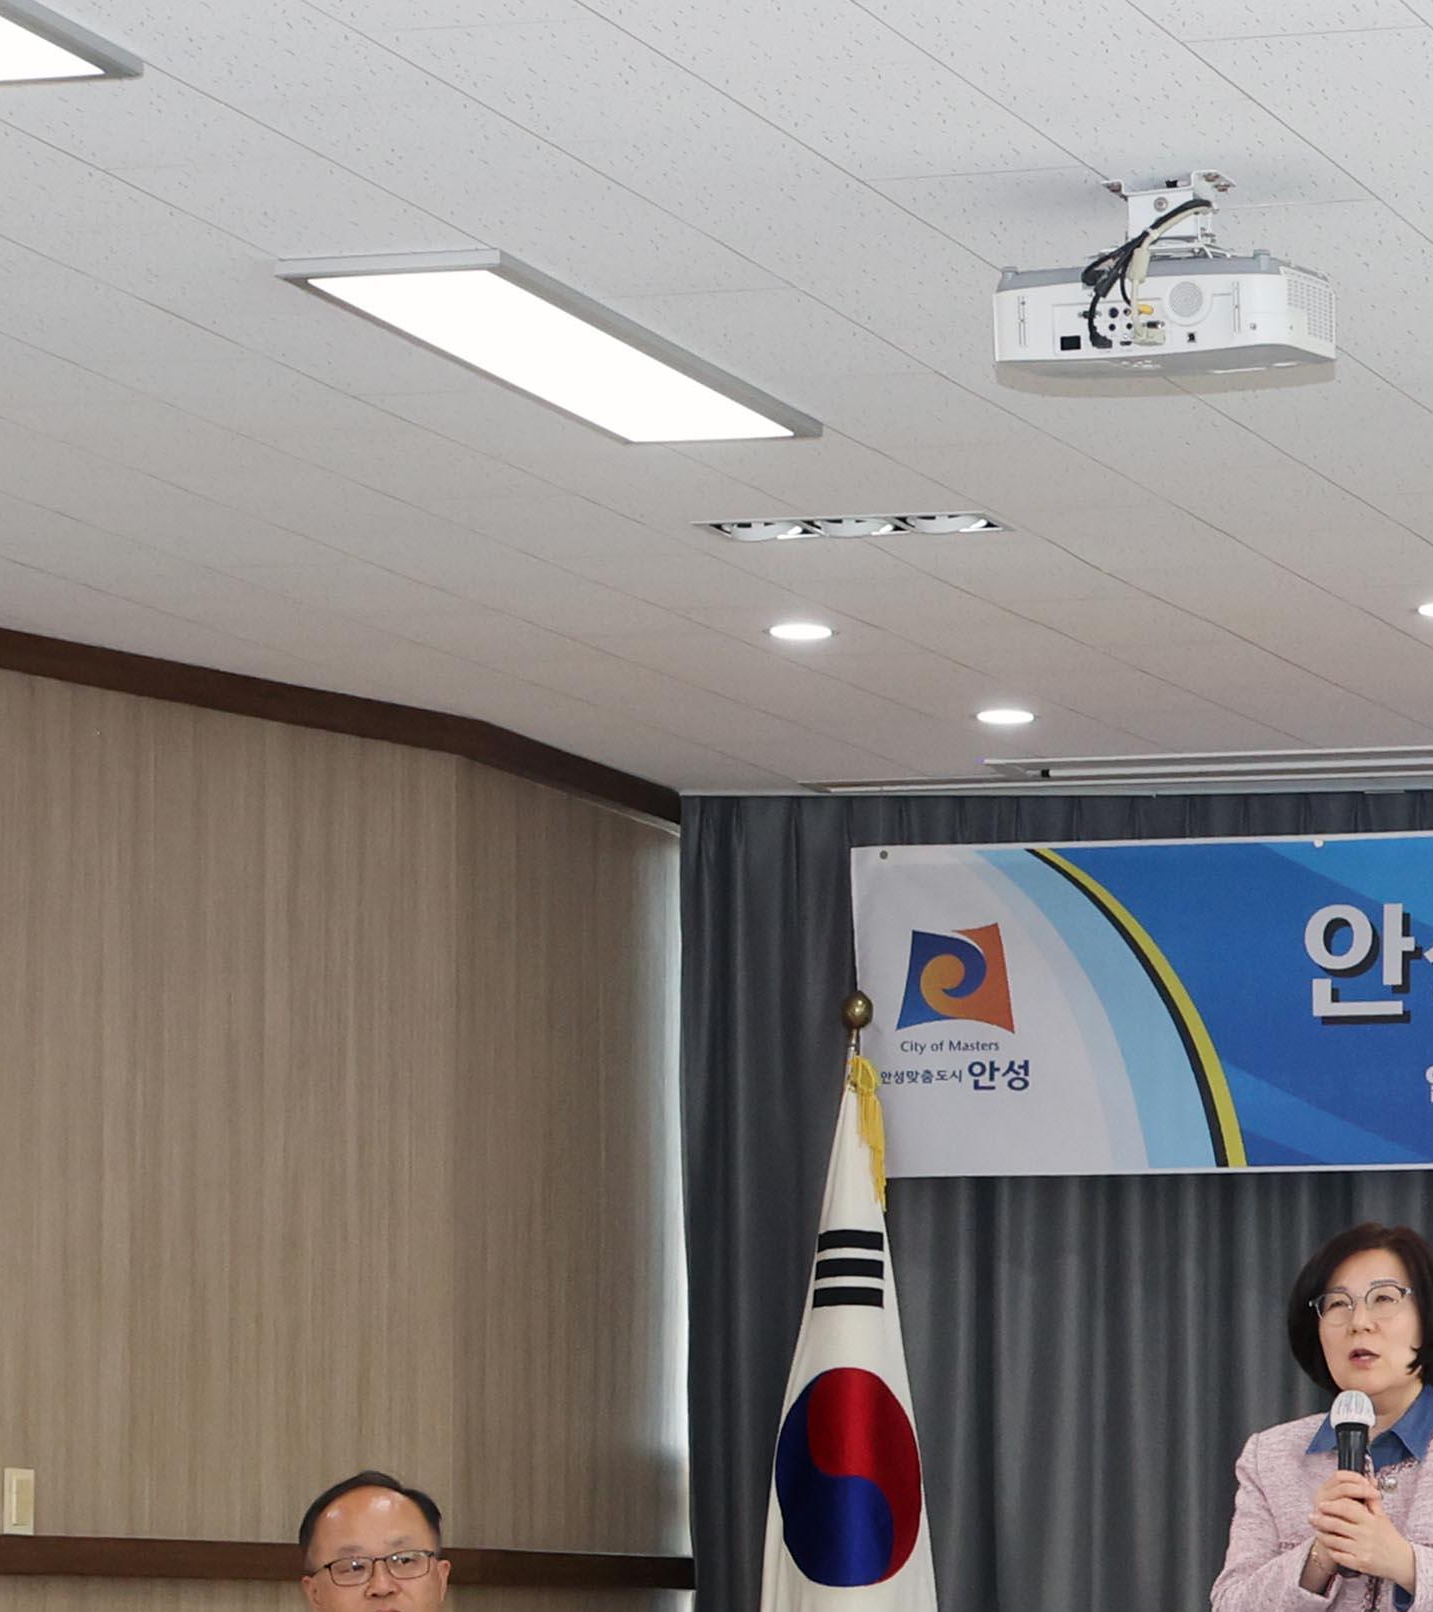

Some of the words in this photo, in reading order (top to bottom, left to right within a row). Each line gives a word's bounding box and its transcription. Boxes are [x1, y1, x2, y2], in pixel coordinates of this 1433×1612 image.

[900, 1040, 926, 1055] City
[930, 1040, 944, 1052] of
[949, 1039, 1000, 1052] Masters
[881, 1069, 963, 1085] 안성맞춤도시
[967, 1058, 1031, 1092] 안성
